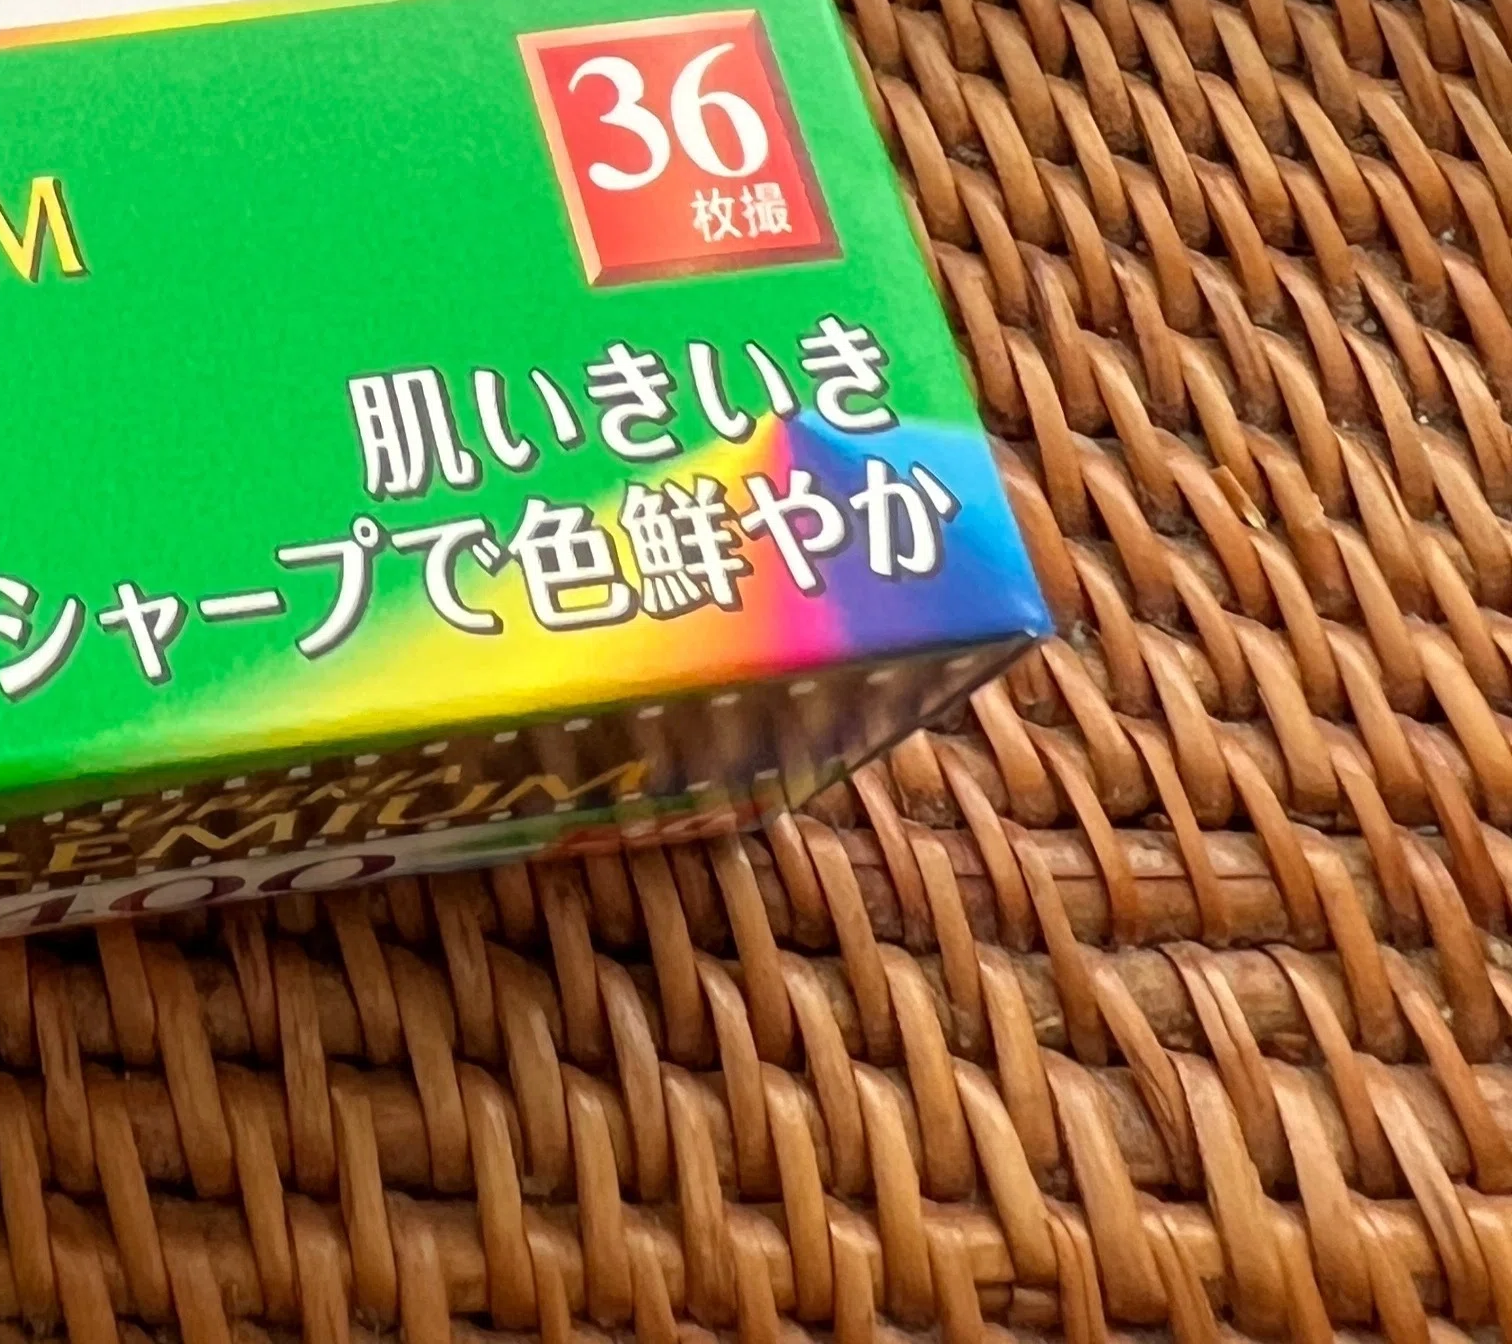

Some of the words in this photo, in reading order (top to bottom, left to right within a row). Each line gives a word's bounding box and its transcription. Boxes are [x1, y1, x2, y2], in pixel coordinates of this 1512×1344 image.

[567, 42, 771, 192] 36
[690, 181, 794, 244] 枚撮
[346, 312, 901, 502] 肌いきいき
